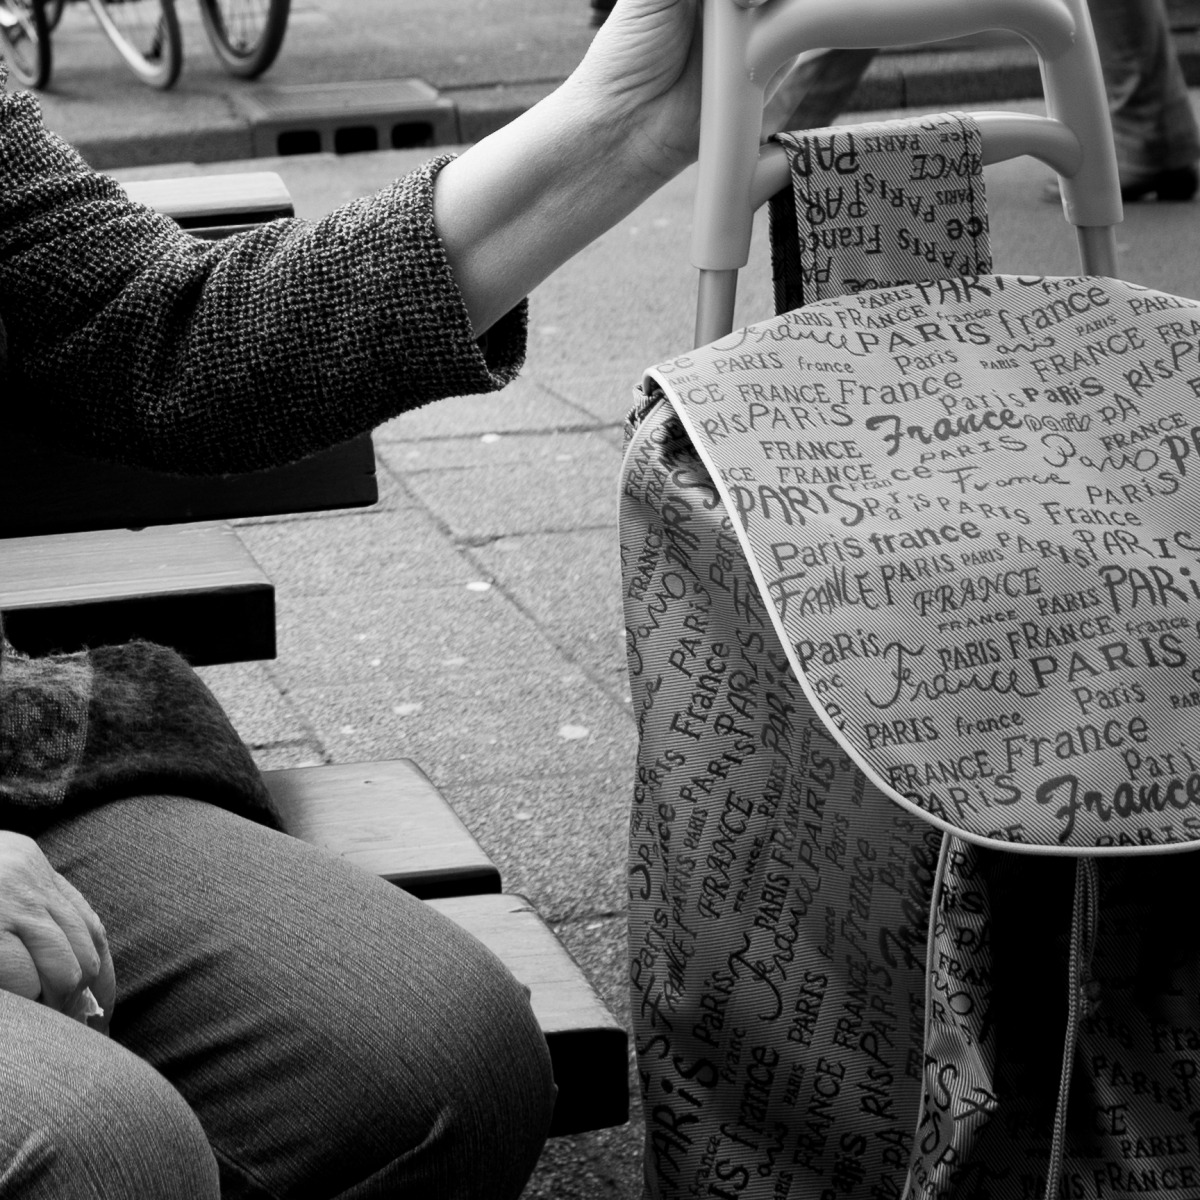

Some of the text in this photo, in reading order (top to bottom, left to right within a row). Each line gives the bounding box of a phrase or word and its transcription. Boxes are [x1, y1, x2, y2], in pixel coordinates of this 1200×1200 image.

[864, 134, 920, 154] PARIS
[863, 173, 936, 224] PARIS
[898, 228, 970, 276] PARIS
[835, 303, 928, 329] FRANCE
[856, 288, 915, 309] PARIS
[936, 307, 992, 323] france
[998, 286, 1110, 339] france
[783, 311, 833, 327] PARIS
[1075, 315, 1118, 337] PARIS
[856, 322, 991, 354] PARIS
[1030, 326, 1146, 383] FRANCE
[712, 351, 784, 375] PARIS
[798, 356, 855, 374] france
[892, 350, 958, 376] Paris
[979, 358, 1021, 371] PARIS
[734, 383, 831, 404] FRANCE
[837, 371, 964, 406] France
[865, 408, 1023, 457] France
[919, 435, 1027, 465] PARIS
[1100, 412, 1188, 452] FRANCE
[759, 440, 863, 461] FRANCE
[776, 463, 877, 484] FRANCE
[936, 495, 1031, 525] PARIS
[1040, 502, 1142, 527] France
[770, 534, 866, 572] Paris
[869, 520, 982, 556] france
[995, 531, 1091, 570] PARIS
[627, 523, 665, 601] FRANCE
[960, 548, 1005, 567] PARIS
[880, 552, 958, 606] PARIS
[913, 567, 1043, 617] FRANCE
[1036, 587, 1101, 616] PARIS
[936, 609, 1020, 634] FRANCE
[1006, 615, 1116, 660] FRANCE
[1124, 616, 1191, 636] france
[936, 638, 1003, 672] PARIS
[1028, 632, 1188, 690] PARIS
[668, 642, 730, 742] France
[1071, 681, 1147, 716] Paris
[863, 715, 939, 751] PARIS
[956, 711, 1025, 737] france
[1001, 714, 1149, 775] France
[679, 739, 756, 803] PARIS
[886, 749, 995, 790] FRANCE
[683, 807, 709, 850] PARIS
[798, 749, 836, 874] PARIS
[698, 789, 754, 919] FRANCE
[753, 872, 791, 933] PARIS
[841, 838, 878, 961] France
[787, 971, 828, 1048] PARIS
[833, 955, 868, 1051] FRANCE
[720, 1045, 780, 1151] france
[793, 1056, 848, 1177] FRANCE
[1120, 1134, 1188, 1159] PARIS
[1094, 1161, 1199, 1199] FRANCE
